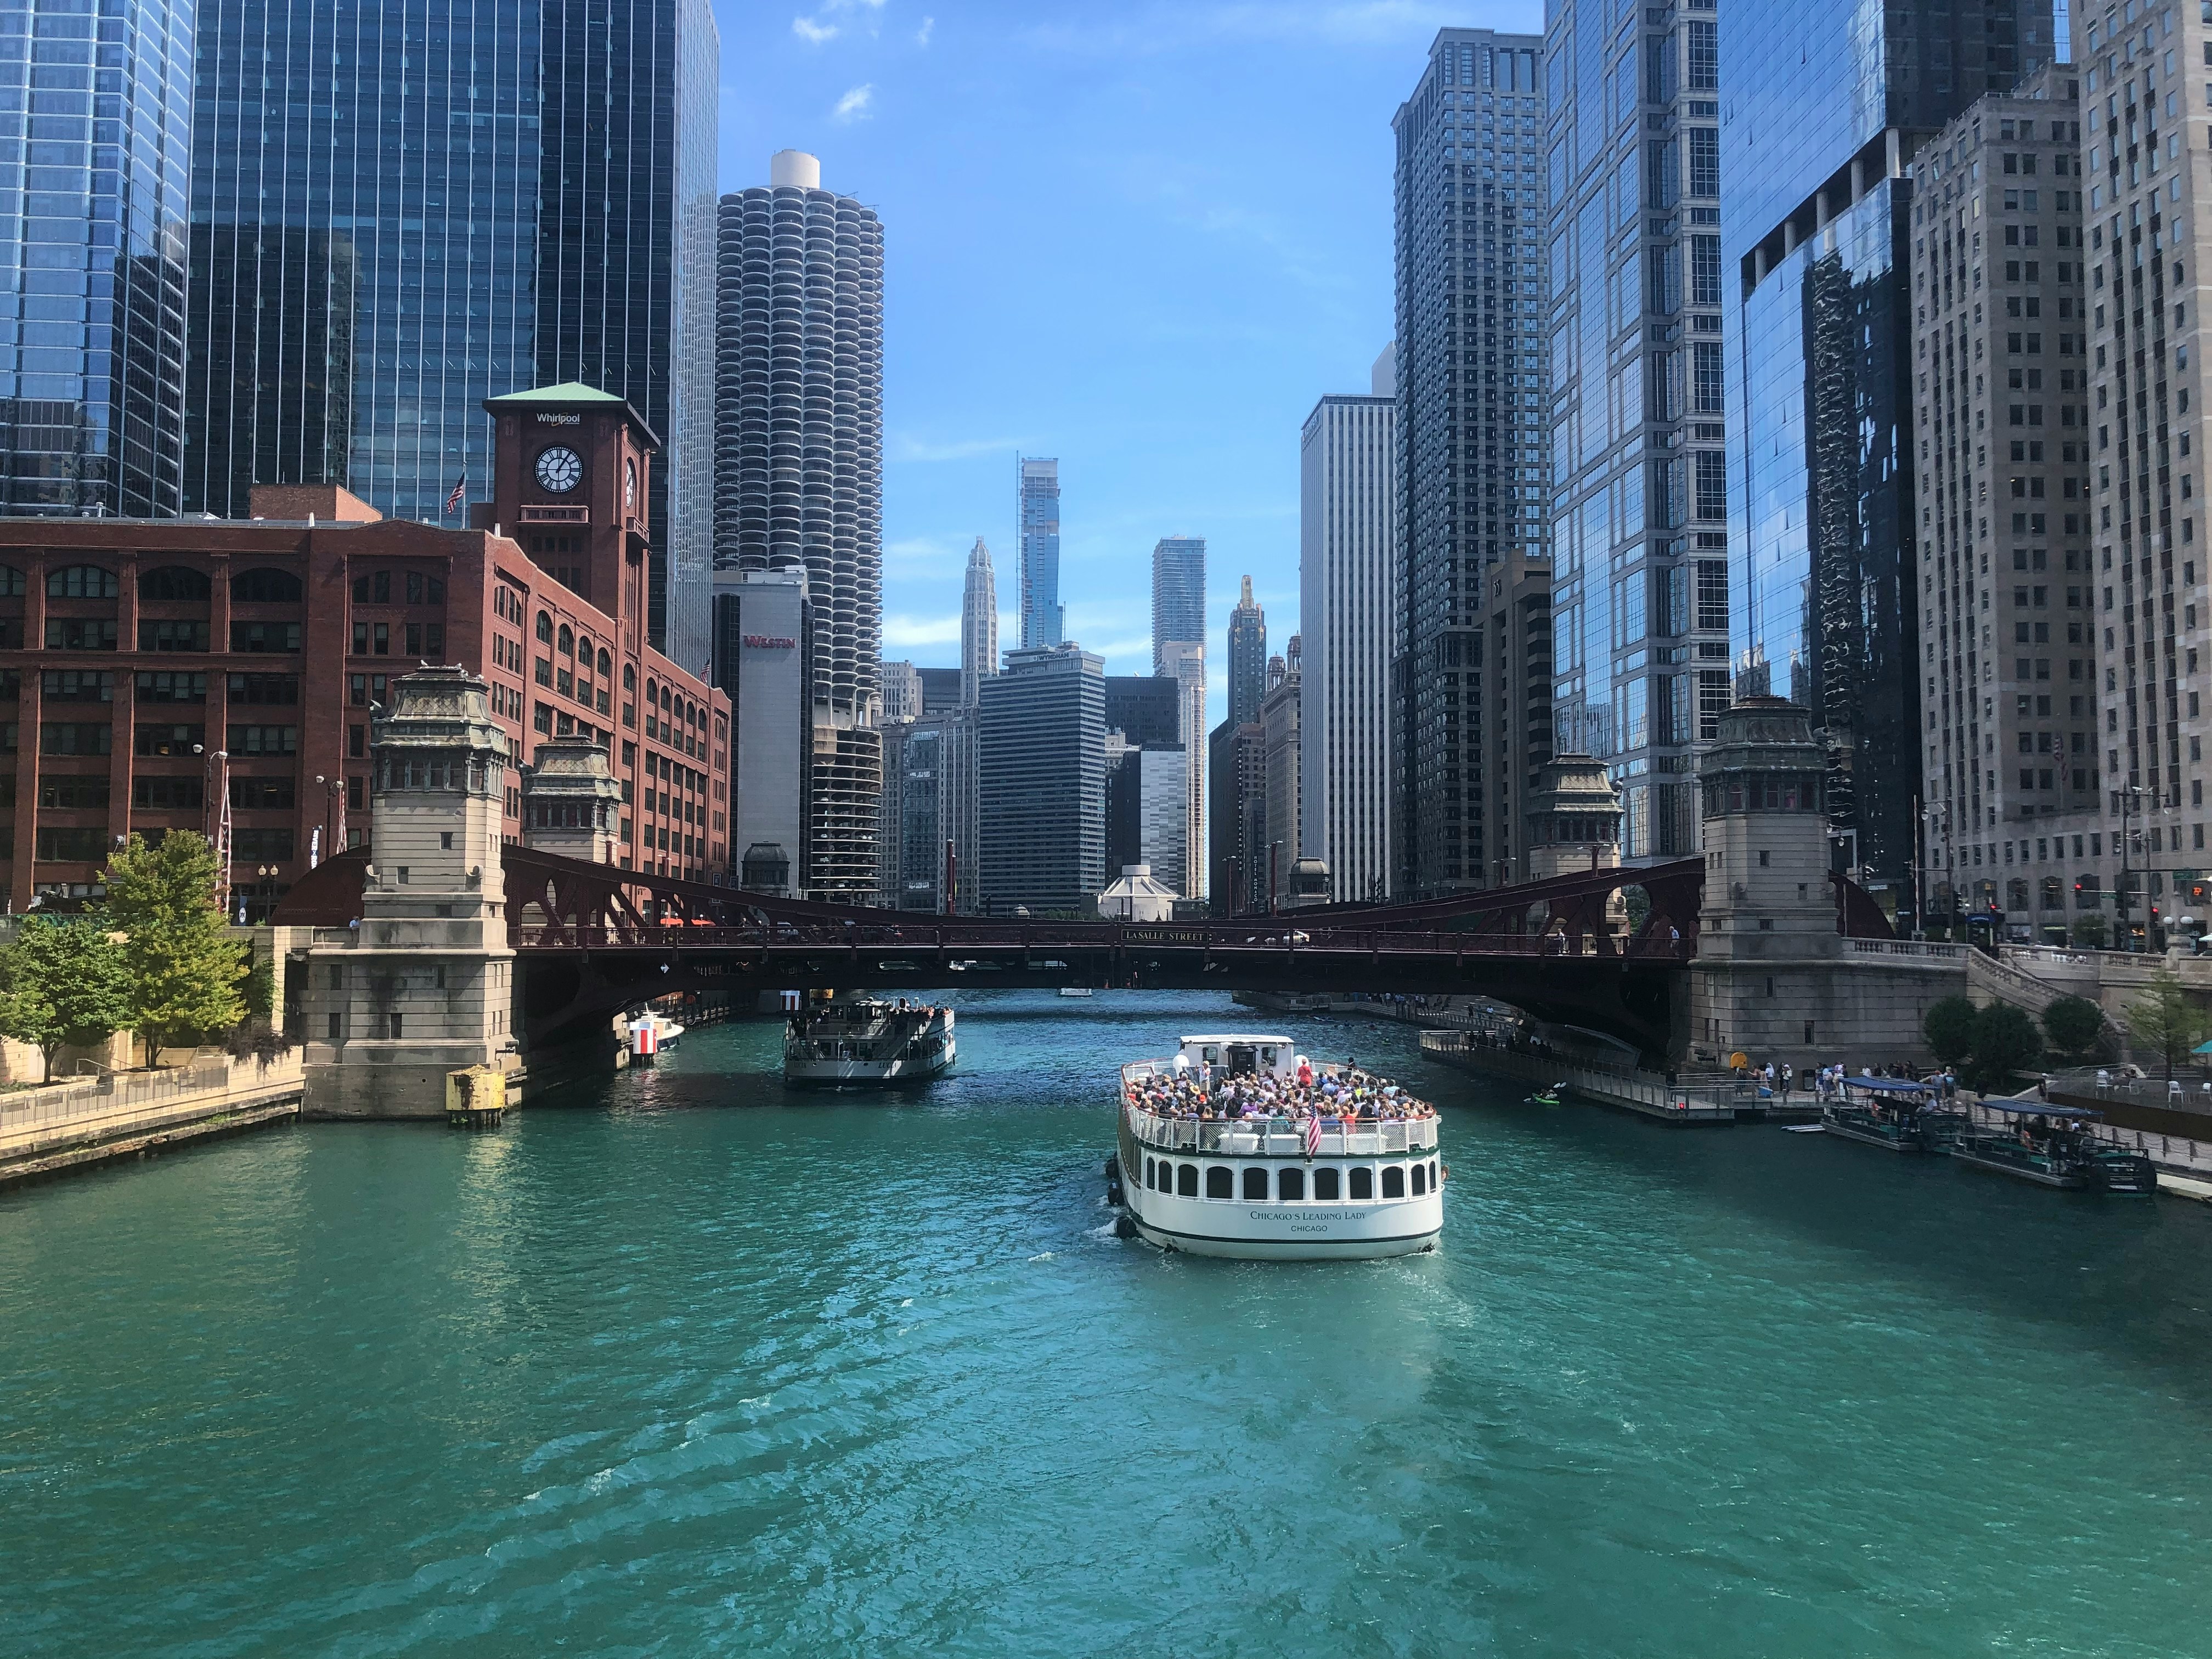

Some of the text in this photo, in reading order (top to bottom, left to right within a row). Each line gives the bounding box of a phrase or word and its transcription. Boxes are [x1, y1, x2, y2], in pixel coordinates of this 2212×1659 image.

[537, 413, 580, 425] Whirlpool
[743, 635, 795, 648] WESTIN
[1039, 652, 1069, 661] WYNDHAM
[1169, 933, 1204, 941] STREET
